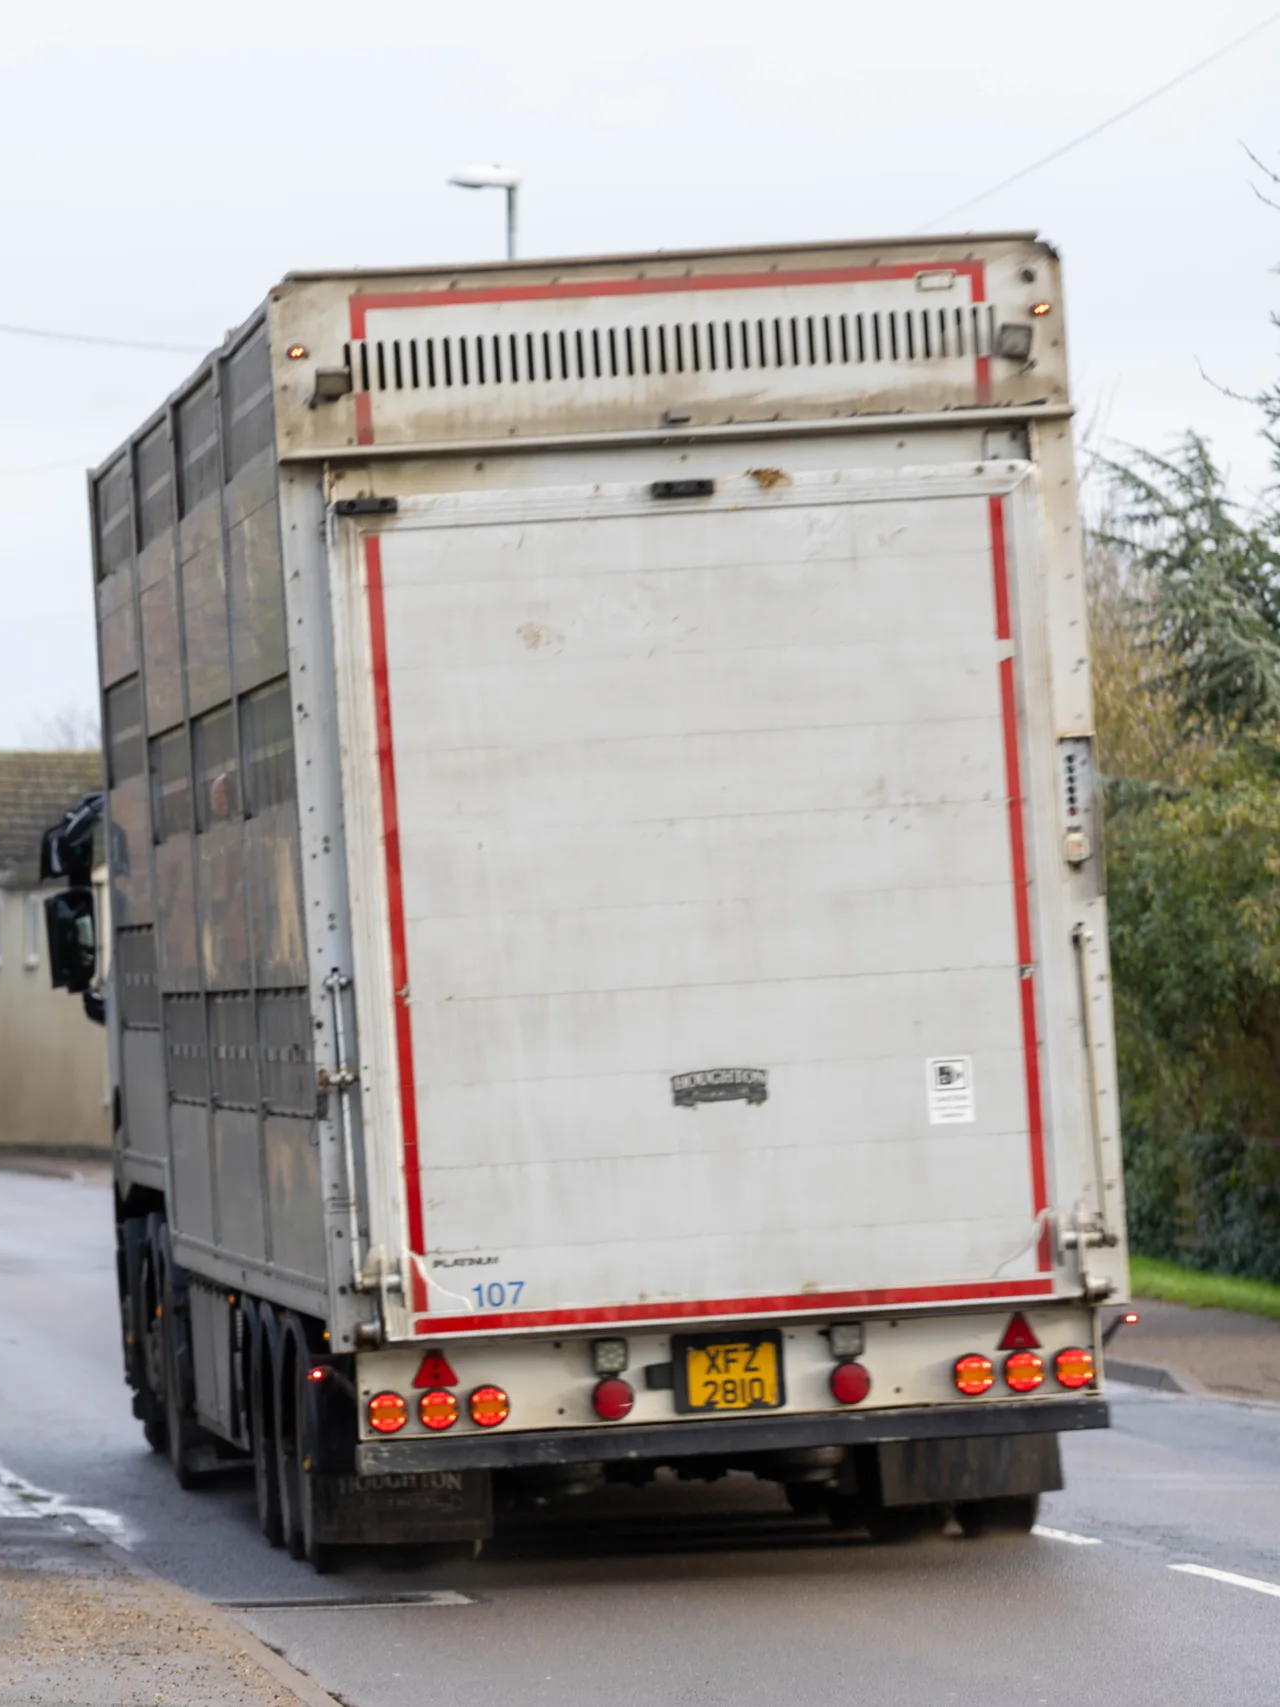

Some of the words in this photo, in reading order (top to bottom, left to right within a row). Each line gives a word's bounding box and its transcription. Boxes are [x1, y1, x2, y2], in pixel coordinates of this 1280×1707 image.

[472, 1281, 524, 1307] 107
[705, 1346, 759, 1374] XFZ
[703, 1378, 764, 1405] 2810
